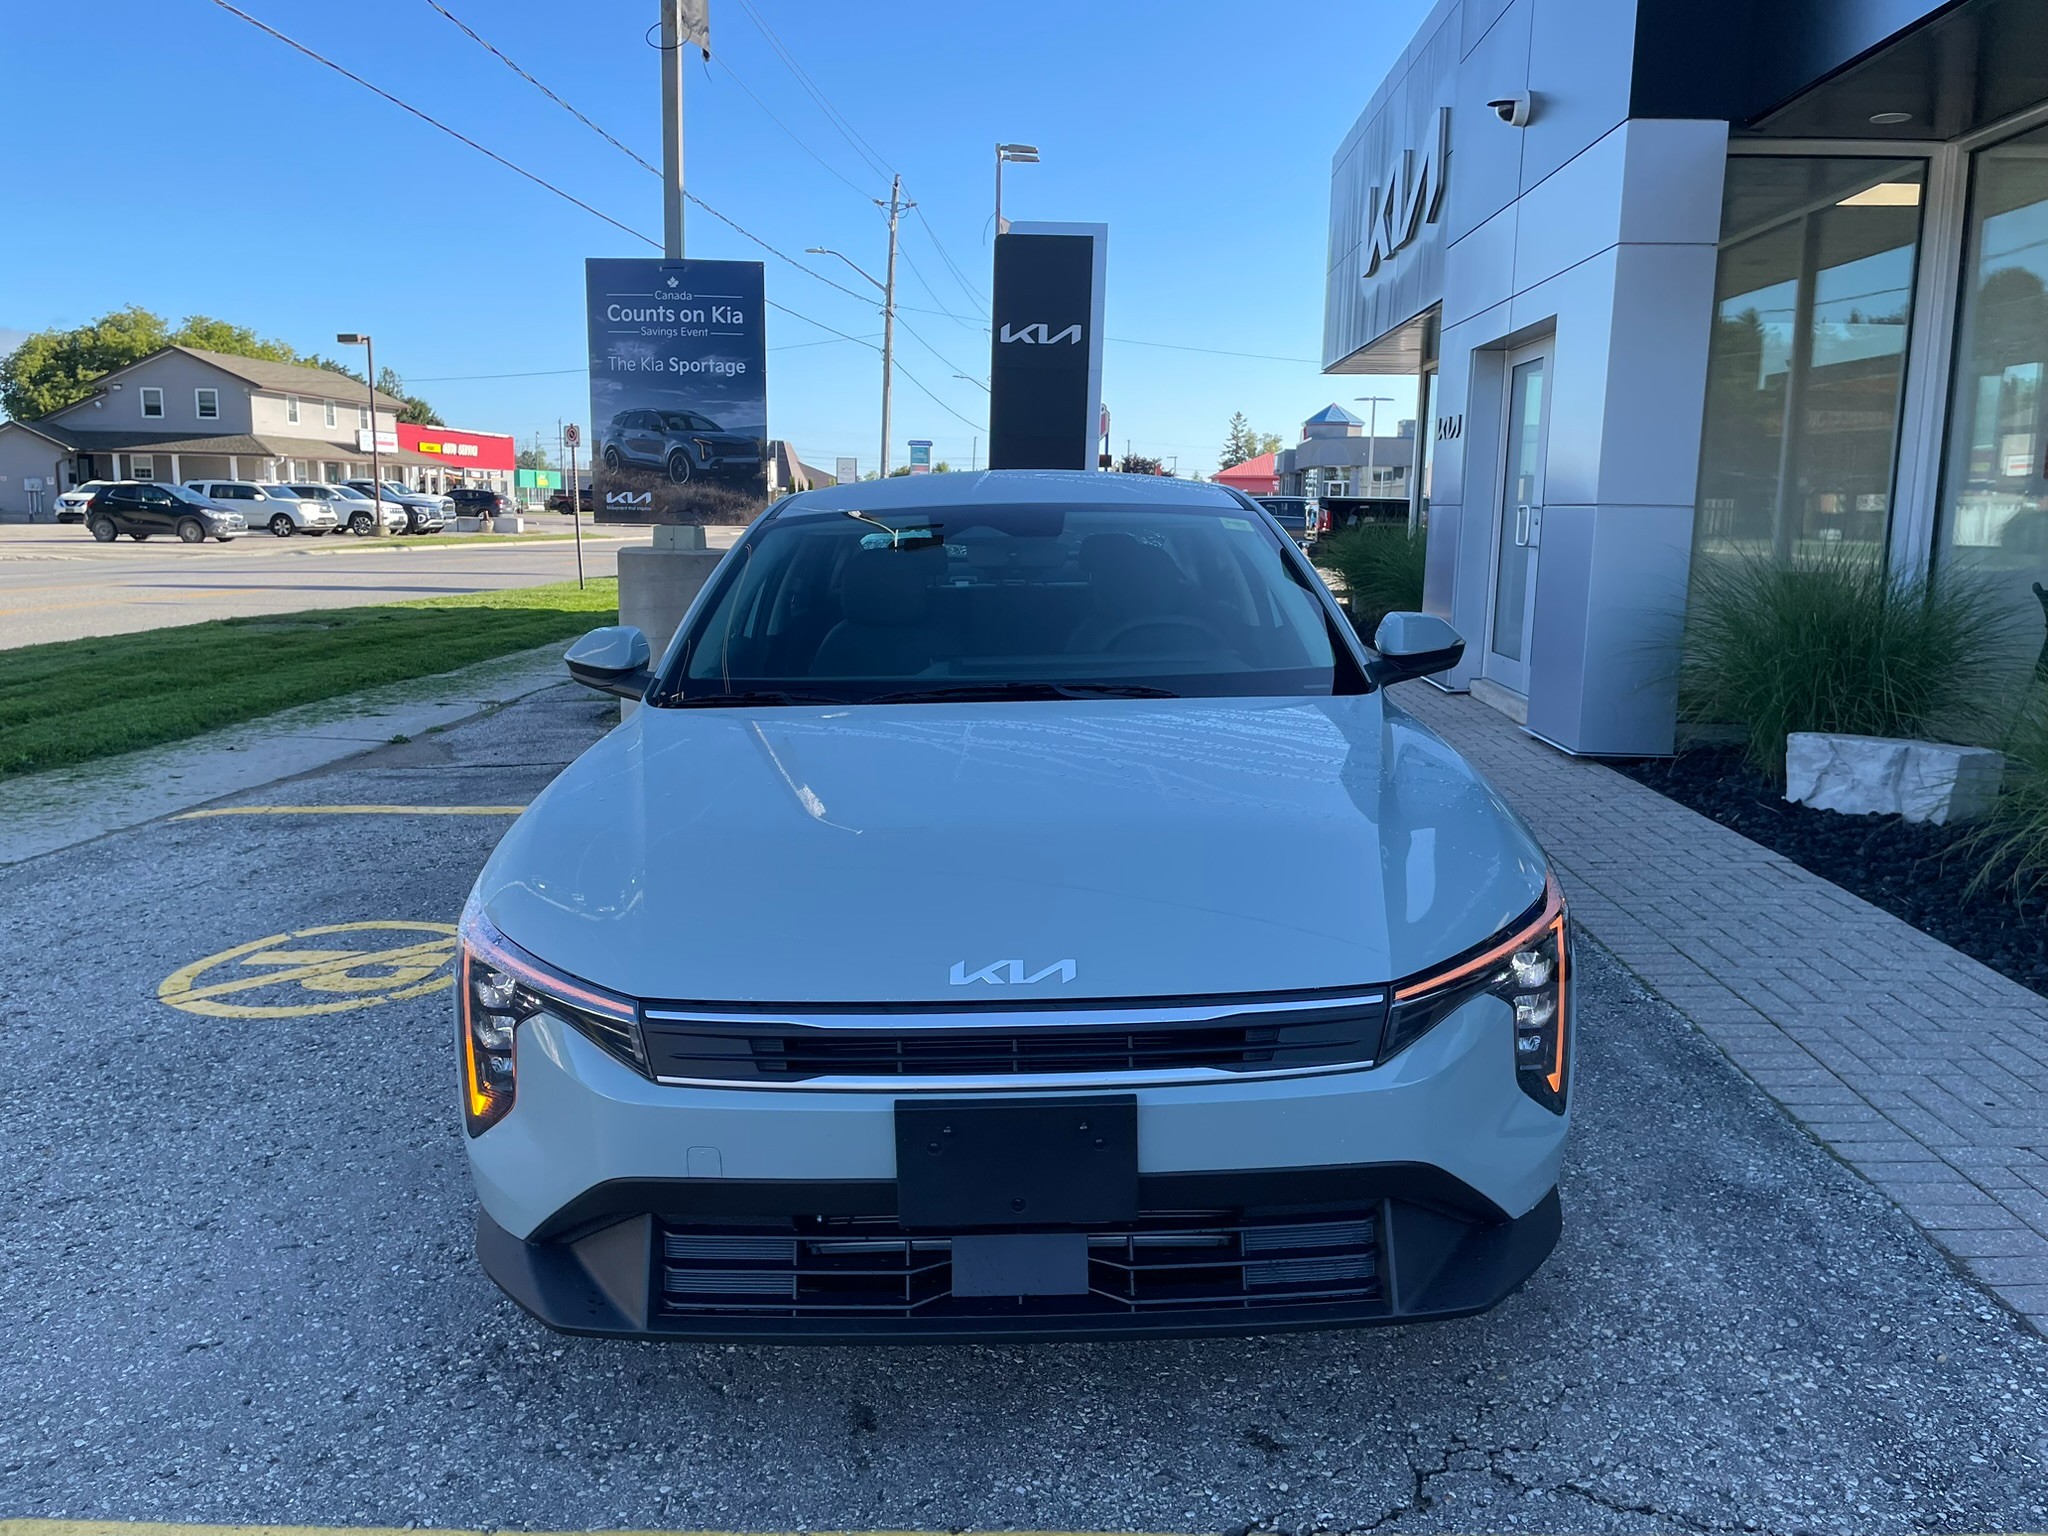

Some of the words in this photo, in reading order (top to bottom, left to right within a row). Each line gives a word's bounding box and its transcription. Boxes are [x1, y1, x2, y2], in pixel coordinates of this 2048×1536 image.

[1360, 106, 1451, 278] KIA
[654, 290, 693, 301] Canada
[607, 304, 676, 323] Counts
[679, 309, 705, 323] on
[711, 305, 743, 324] Kia
[640, 326, 678, 338] Savings
[680, 326, 709, 337] Event
[1000, 322, 1082, 345] KIA
[607, 356, 636, 371] The
[640, 356, 664, 371] Kia
[669, 356, 746, 377] Sportage
[605, 491, 652, 504] KIA
[949, 958, 1077, 986] KIA
